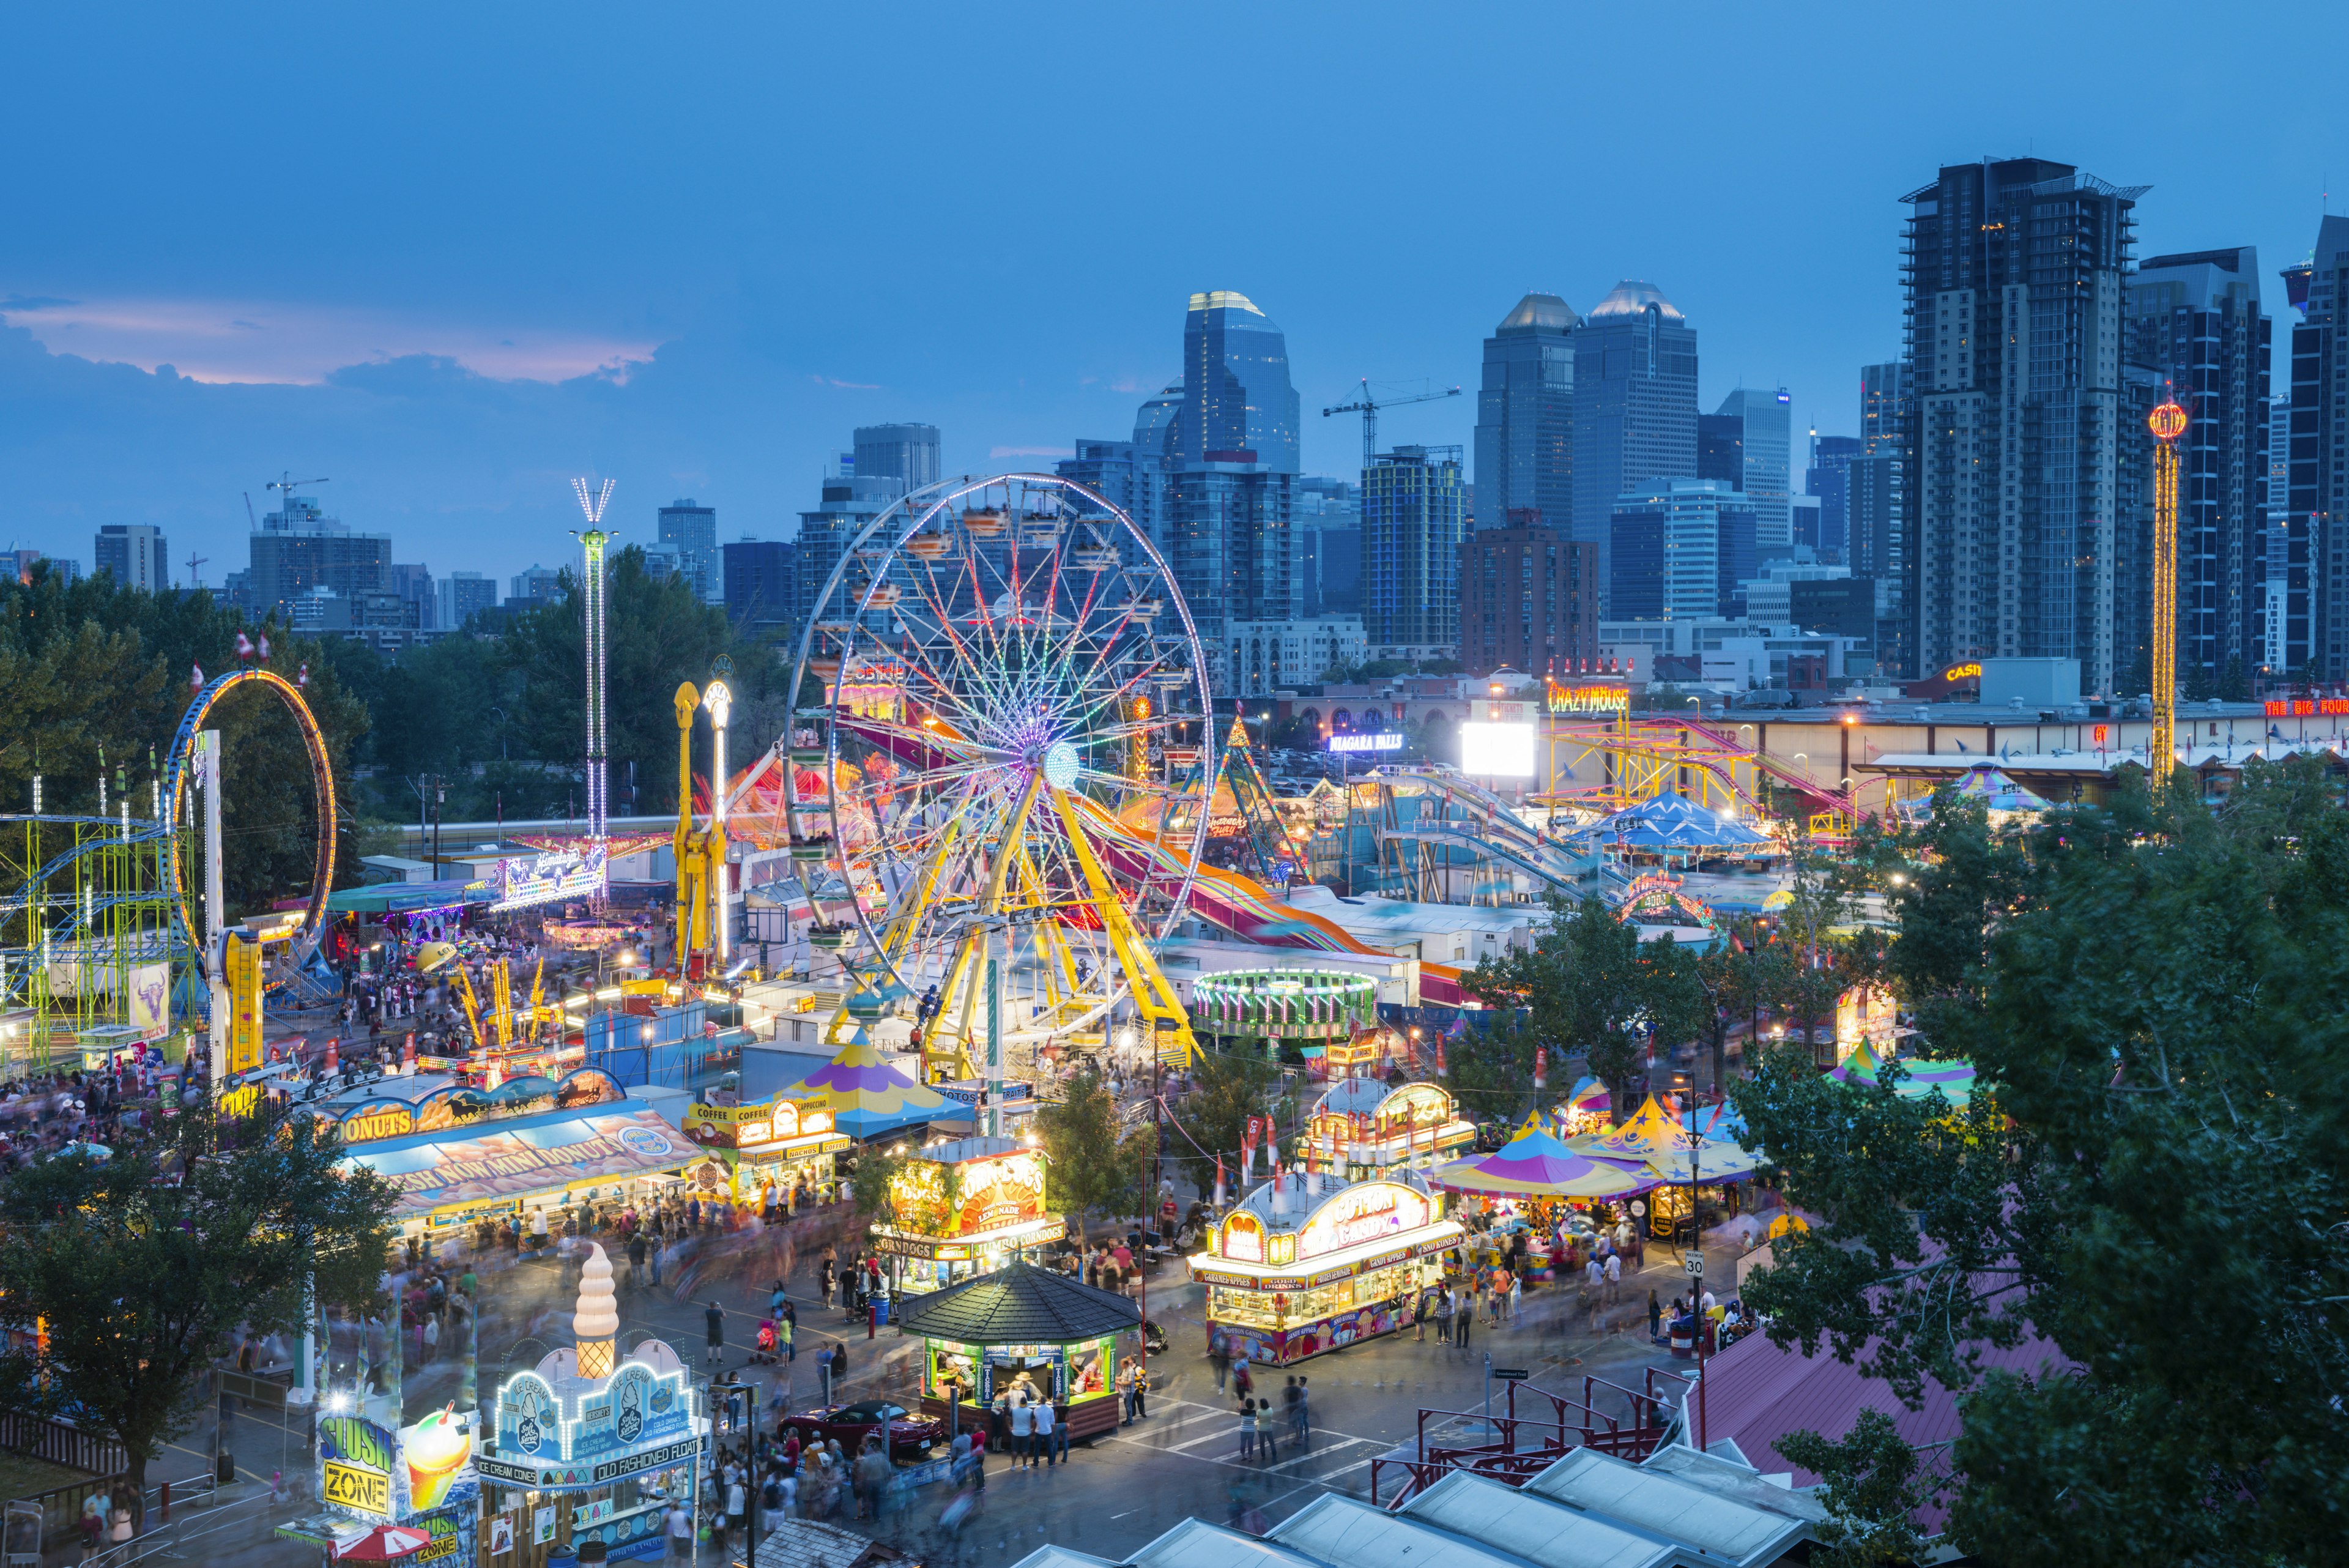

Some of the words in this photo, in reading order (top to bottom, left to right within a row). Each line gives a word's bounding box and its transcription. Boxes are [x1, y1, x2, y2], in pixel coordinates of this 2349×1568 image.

[1549, 683, 1589, 712] CRAZY
[1590, 686, 1628, 711] MOUSE
[2265, 702, 2286, 715] THE
[2294, 700, 2313, 714] BIG
[2320, 699, 2349, 714] FOUR
[1329, 736, 1373, 751] NIAGARA
[1375, 734, 1402, 750] FALLS
[1211, 826, 1235, 837] Fury
[535, 849, 579, 874] Himalaya
[115, 1033, 138, 1042] PHOTOS
[1331, 1049, 1346, 1059] Rides
[1003, 1089, 1025, 1099] TRAITS
[798, 1099, 826, 1112] CAPPUCCINO
[697, 1108, 727, 1120] COFFEE
[738, 1109, 768, 1120] COFFEE
[789, 1148, 817, 1158] NACHOS
[825, 1142, 846, 1151] COFFEE
[492, 1148, 546, 1177] MINI
[541, 1136, 625, 1167] DONUTS
[758, 1154, 781, 1164] CAPPUCCINO
[435, 1159, 493, 1186] NOW
[954, 1161, 996, 1211] CORN
[1001, 1159, 1044, 1195] DOGS
[1335, 1191, 1393, 1224] COTTON
[1020, 1226, 1063, 1247] CORNDOGS
[1339, 1216, 1390, 1245] CANDY
[976, 1237, 1019, 1257] JUMBO
[1422, 1241, 1436, 1253] SNO
[1436, 1236, 1457, 1249] KONES
[938, 1249, 965, 1259] LEMONADE
[1370, 1257, 1387, 1268] CANDY
[1387, 1252, 1406, 1263] APPLES
[1317, 1272, 1332, 1284] FROZEN
[1332, 1266, 1351, 1280] LEMONADE
[1687, 1261, 1702, 1273] 30
[1204, 1273, 1230, 1284] CARAMEL
[1230, 1275, 1250, 1287] APPLES
[1373, 1302, 1388, 1315] COTTON
[1343, 1314, 1356, 1323] KONES
[1224, 1327, 1245, 1336] COTTON
[1245, 1329, 1263, 1340] CANDY
[1287, 1329, 1301, 1341] CANDY
[1301, 1326, 1316, 1336] APPLES
[612, 1377, 624, 1392] ICE
[625, 1370, 650, 1384] CREAM
[513, 1383, 523, 1396] ICE
[525, 1380, 548, 1402] CREAM
[586, 1408, 610, 1421] HERSHEY'S
[620, 1411, 637, 1428] Soft
[521, 1422, 536, 1437] Soft
[586, 1418, 610, 1429] CHOCOLATE
[620, 1418, 640, 1437] Serve
[653, 1425, 675, 1436] FASHIONED
[320, 1417, 392, 1474] SLUSH
[520, 1432, 539, 1445] Serve
[590, 1436, 606, 1446] CREAM
[575, 1445, 599, 1457] PINEAPPLE
[600, 1441, 612, 1450] WHIP
[598, 1465, 617, 1480] OLD
[618, 1448, 669, 1474] FASHIONED
[671, 1438, 703, 1458] FLOATS
[480, 1461, 489, 1473] ICE
[490, 1463, 513, 1477] CREAM
[514, 1468, 536, 1482] CONES
[327, 1466, 386, 1509] ZONE
[420, 1537, 455, 1560] ZONE
